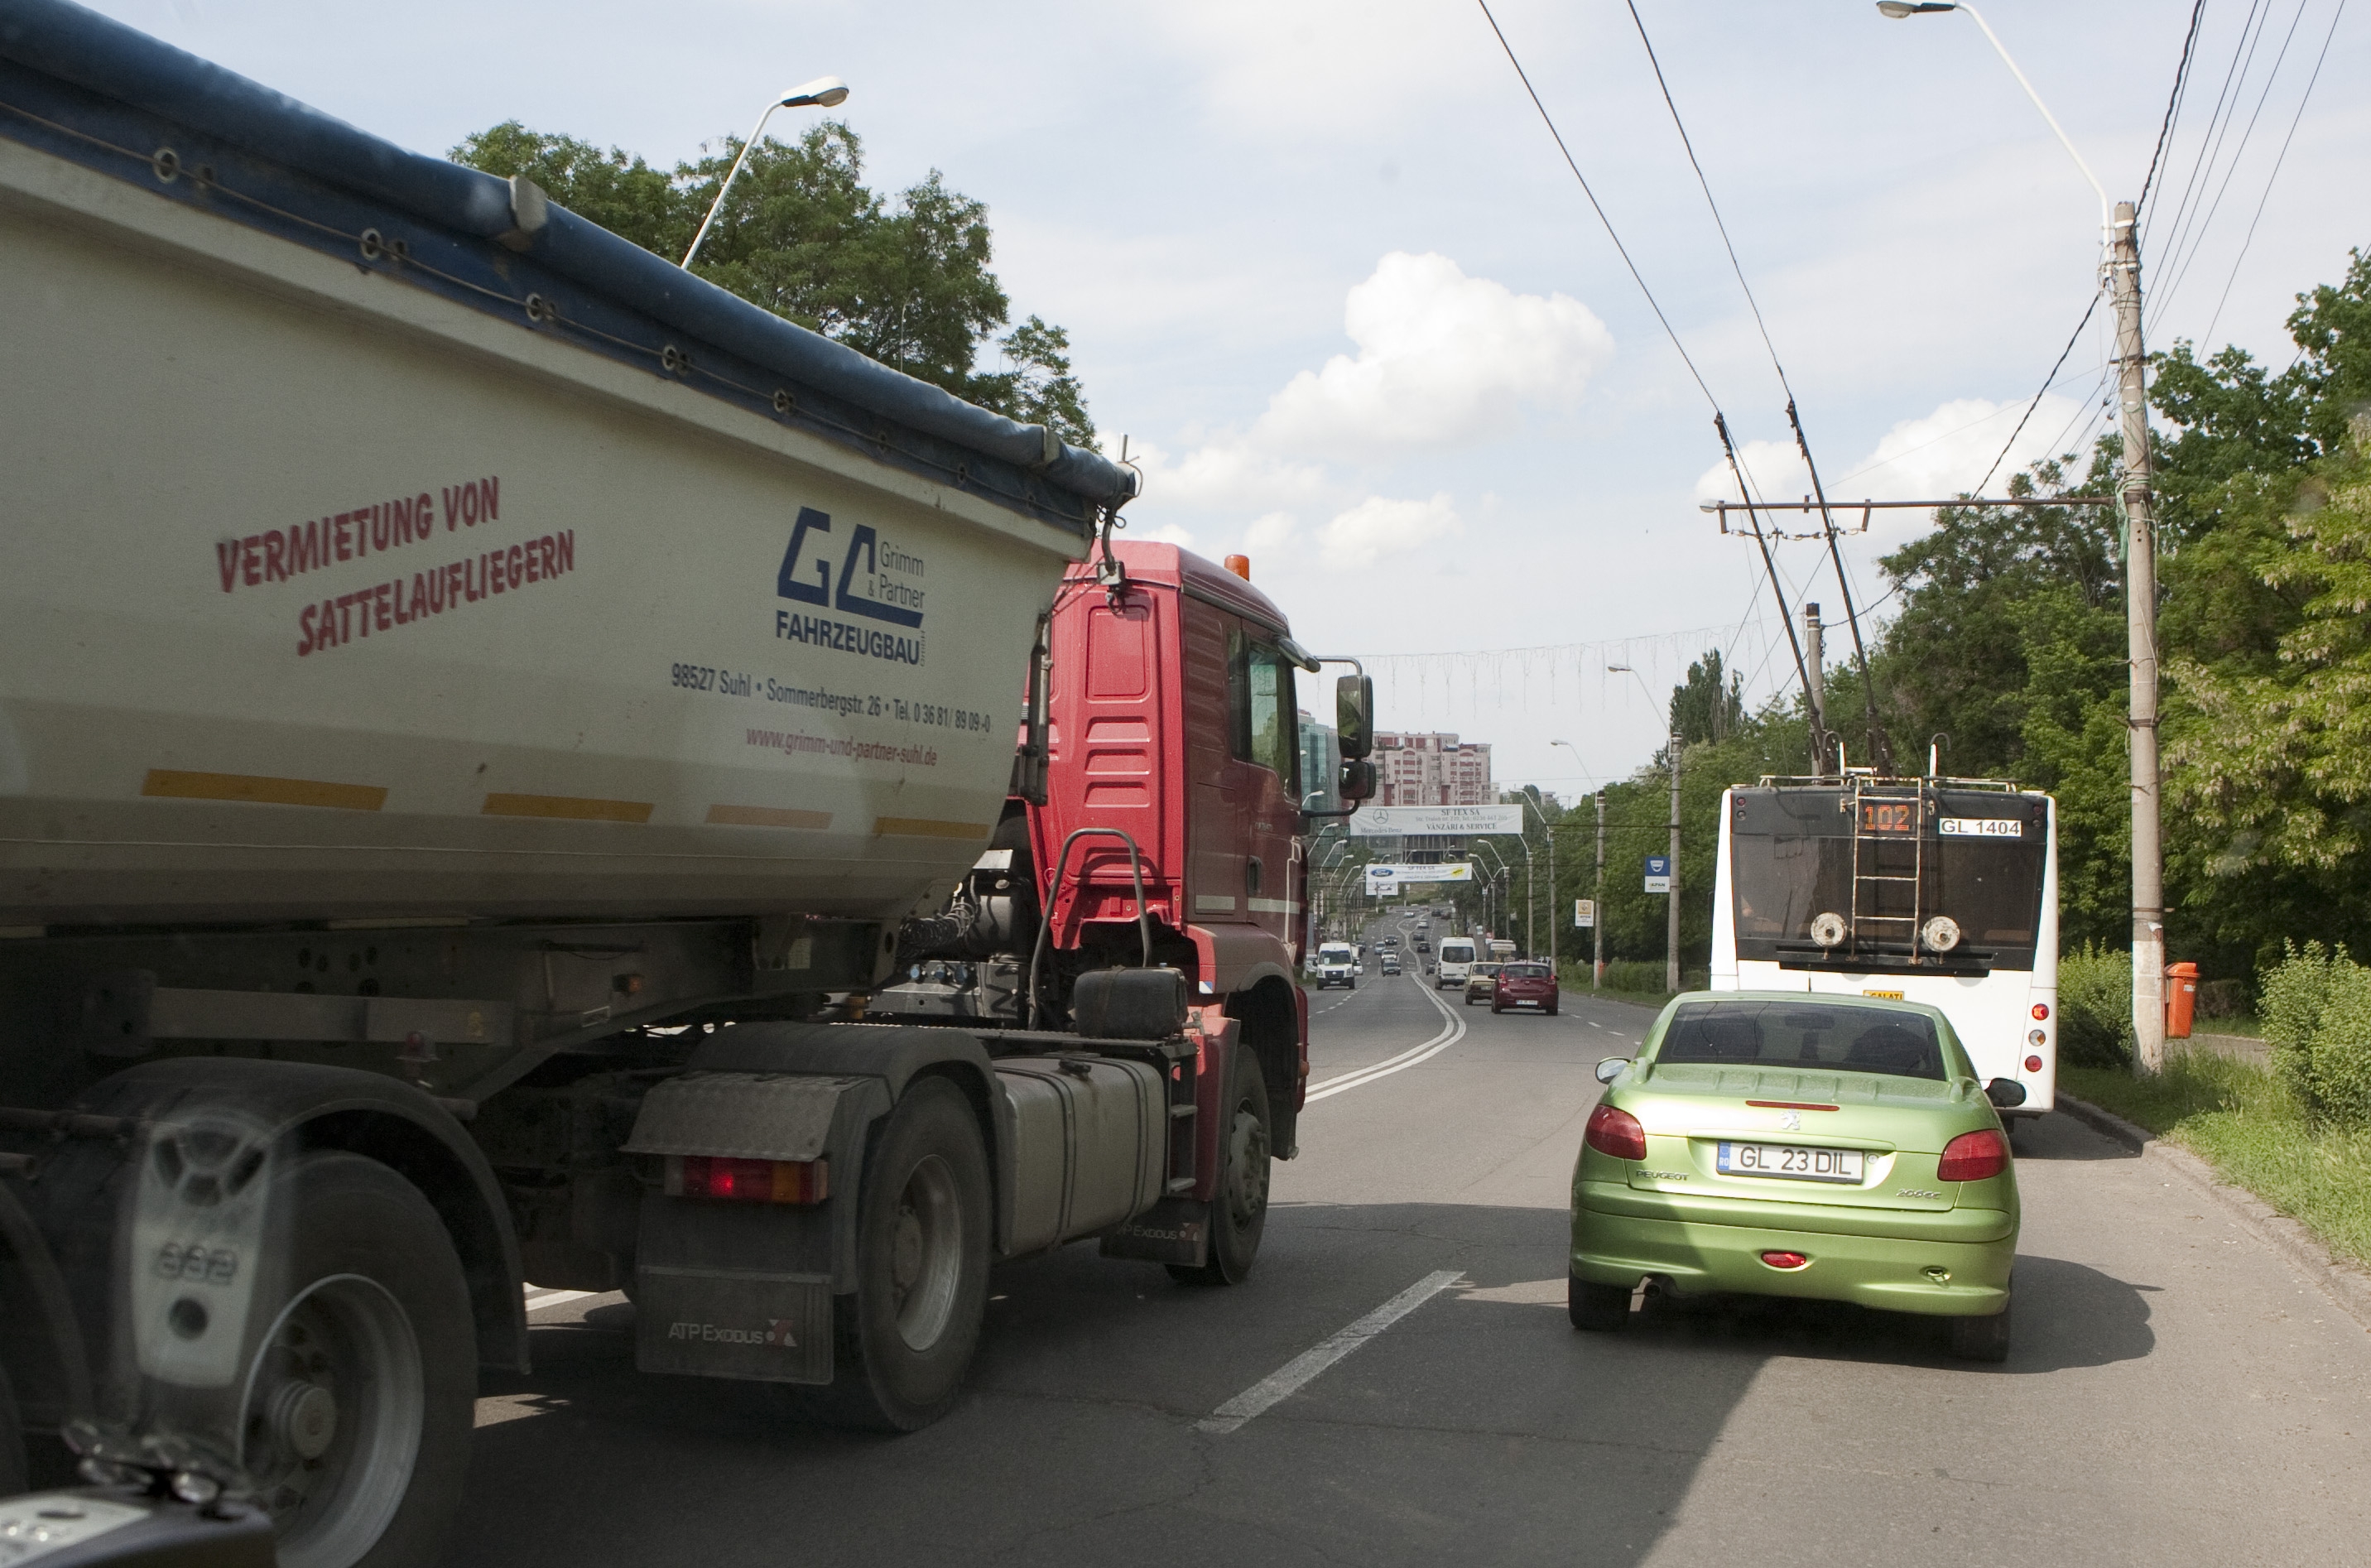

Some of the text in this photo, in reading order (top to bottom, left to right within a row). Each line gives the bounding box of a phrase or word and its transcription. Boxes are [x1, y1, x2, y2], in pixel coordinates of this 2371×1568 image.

[215, 475, 500, 594] VERMIETUNG VON
[880, 541, 924, 577] Grimm
[296, 529, 575, 657] SATTELAUFLIEGERN
[868, 574, 926, 608] & Partner
[776, 609, 920, 665] FAHRZEUGBAU
[671, 663, 716, 692] 98527
[719, 670, 752, 697] Suhl
[767, 677, 864, 717] Sommerbergstr.
[868, 695, 881, 717] 26
[893, 698, 911, 722] Tel.
[746, 729, 937, 767] www.grimm-und-partner-suhl.de
[1865, 805, 1910, 830] 102
[1941, 820, 2020, 835] GL 1404
[1637, 1168, 1689, 1181] PEUGEOT
[1719, 1157, 1729, 1166] RO
[1740, 1147, 1851, 1175] GL 23 DIL
